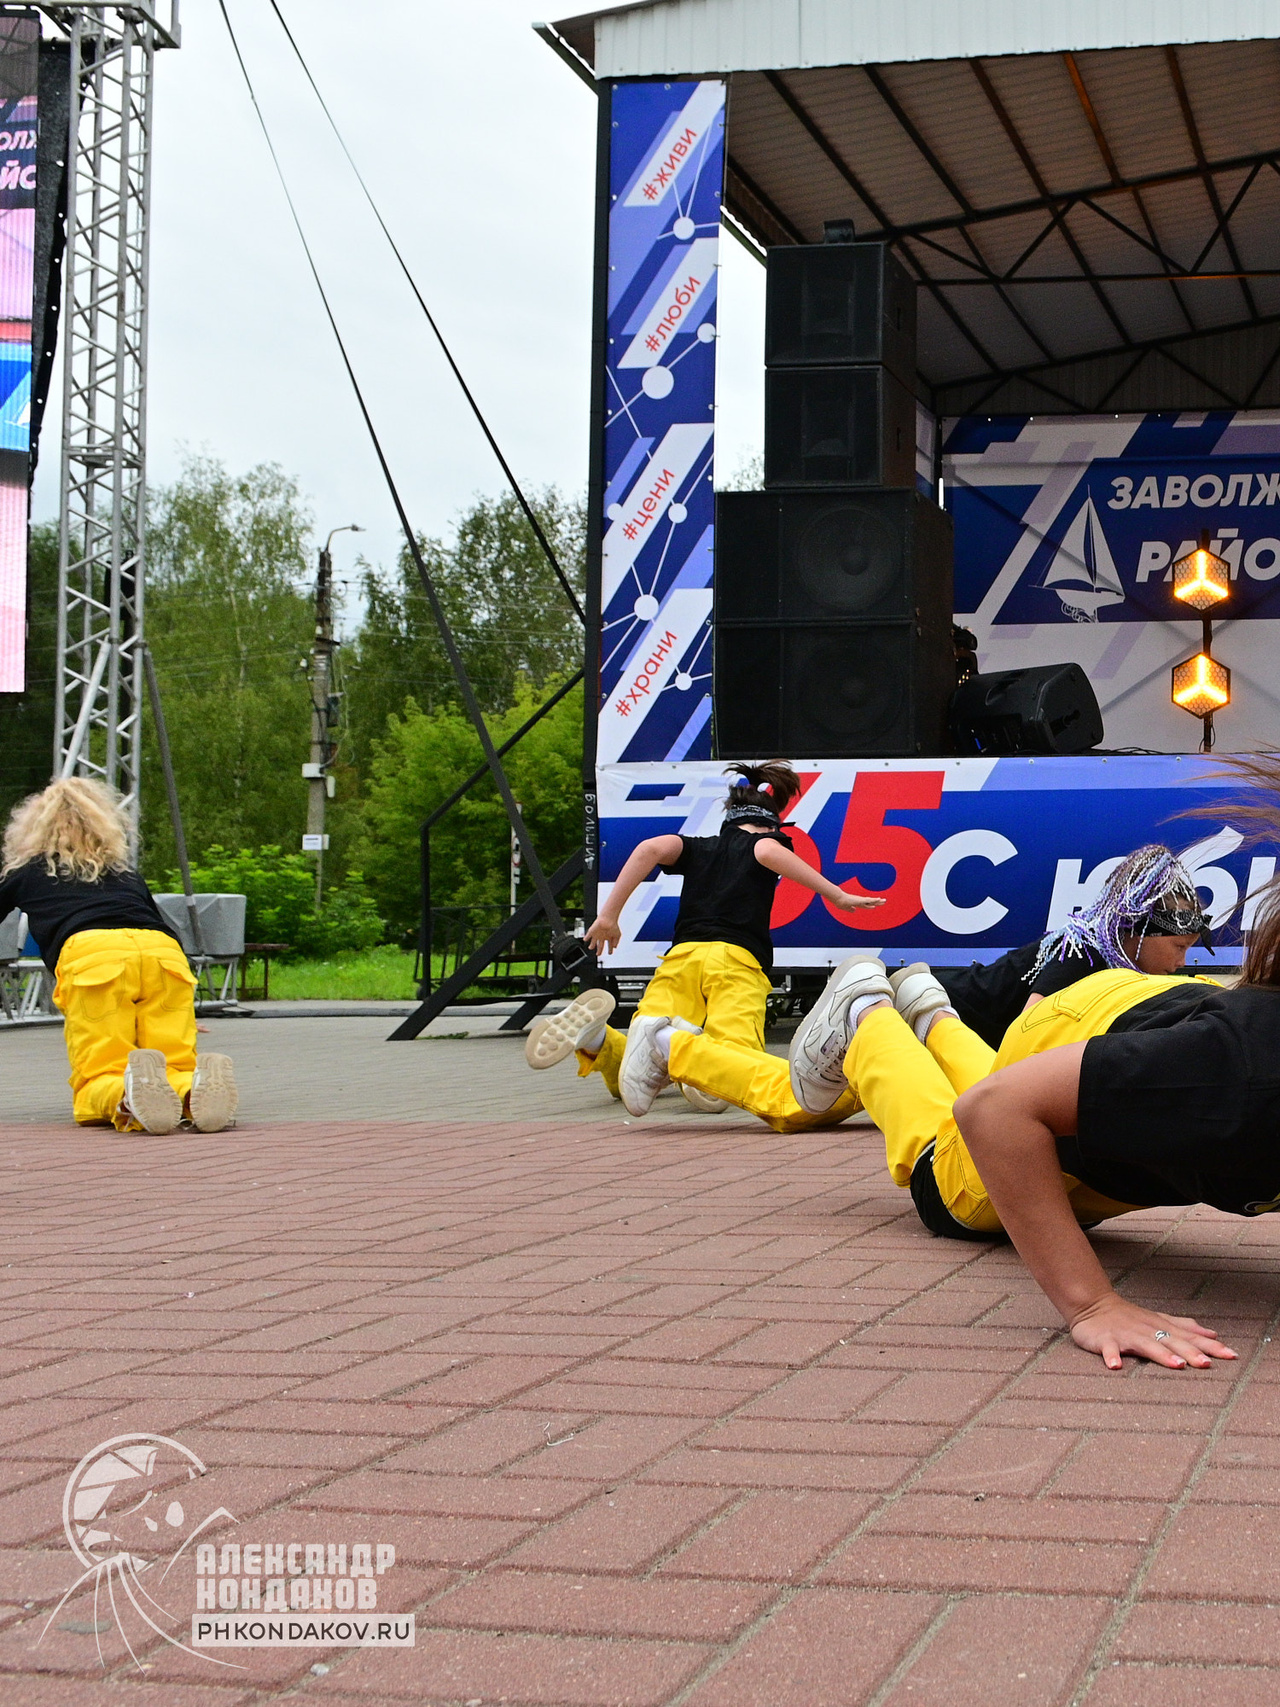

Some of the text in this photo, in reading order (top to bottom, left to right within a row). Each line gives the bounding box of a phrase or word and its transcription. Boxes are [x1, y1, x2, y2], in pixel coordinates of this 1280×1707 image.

[642, 128, 697, 201] #живи
[645, 276, 700, 352] #люби
[622, 469, 675, 540] #цени
[615, 630, 677, 718] #храни
